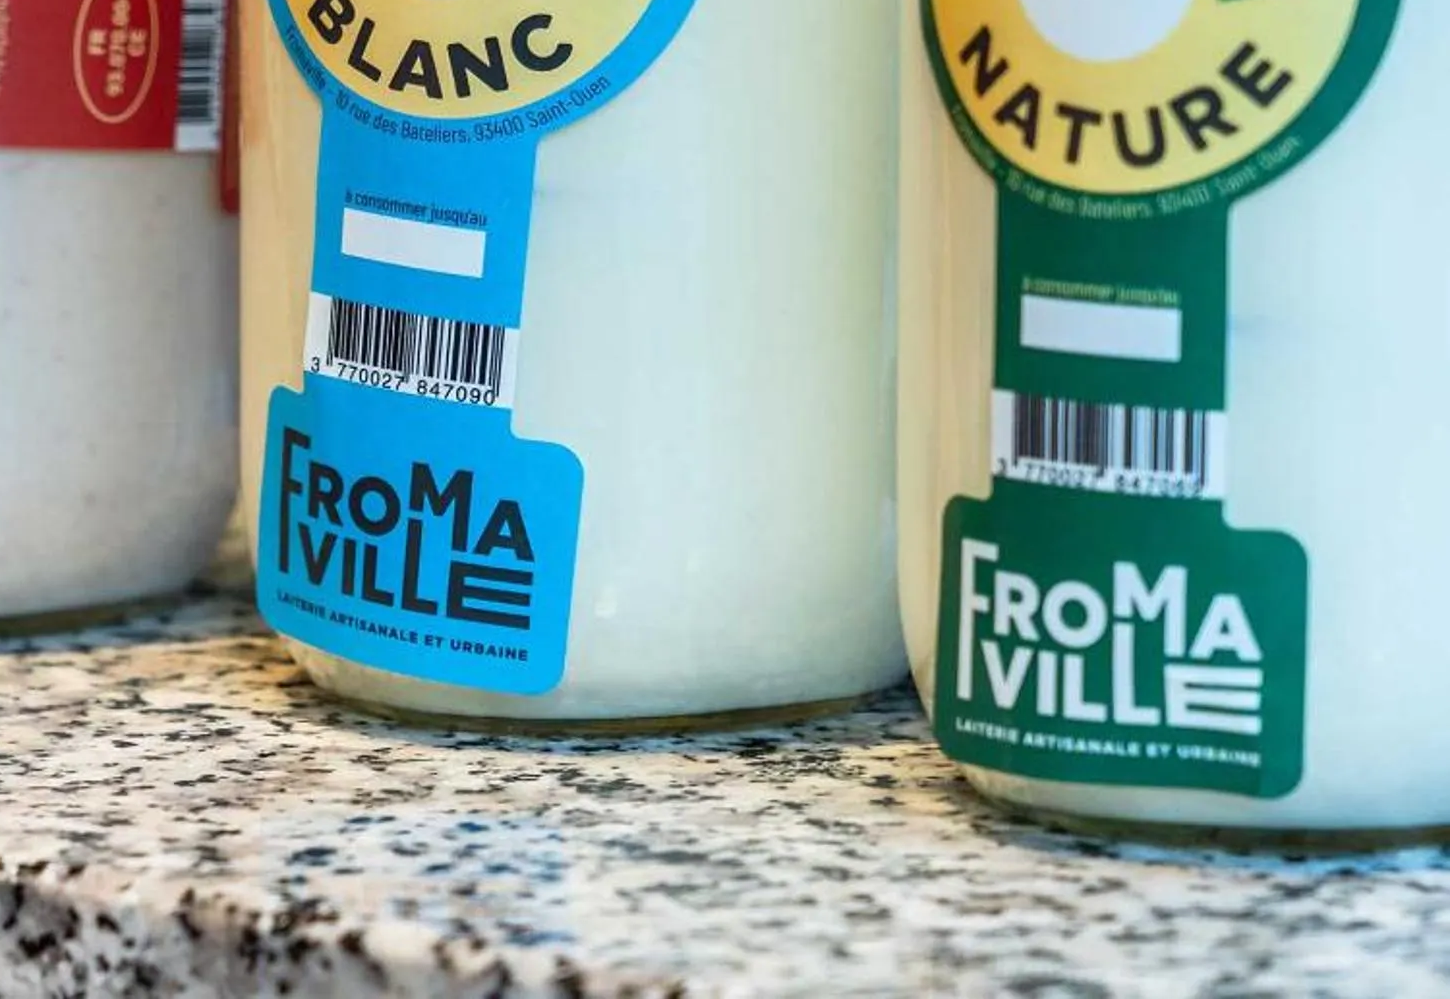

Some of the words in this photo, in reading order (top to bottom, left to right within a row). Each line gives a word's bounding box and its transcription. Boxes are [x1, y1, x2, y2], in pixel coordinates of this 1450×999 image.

[349, 104, 371, 122] rue
[373, 113, 398, 135] des
[474, 117, 525, 143] 93400
[529, 73, 612, 130] Saint-Ouen
[959, 25, 1294, 168] NATURE
[355, 191, 427, 218] consommer
[430, 203, 488, 228] jusqu'au
[310, 356, 321, 374] 3
[337, 361, 405, 391] 770027
[416, 379, 496, 407] 847090
[278, 427, 535, 573] FROMA
[297, 519, 534, 631] VILLE
[956, 537, 1263, 700] FROMA
[277, 587, 325, 620] LAITERIE
[329, 609, 419, 645] ARTISANALE
[424, 634, 445, 649] ET
[450, 638, 529, 662] URBAINE
[980, 622, 1263, 735] VILLE
[955, 716, 1019, 744] LAITERIE
[1022, 731, 1142, 757] ARTISANALE
